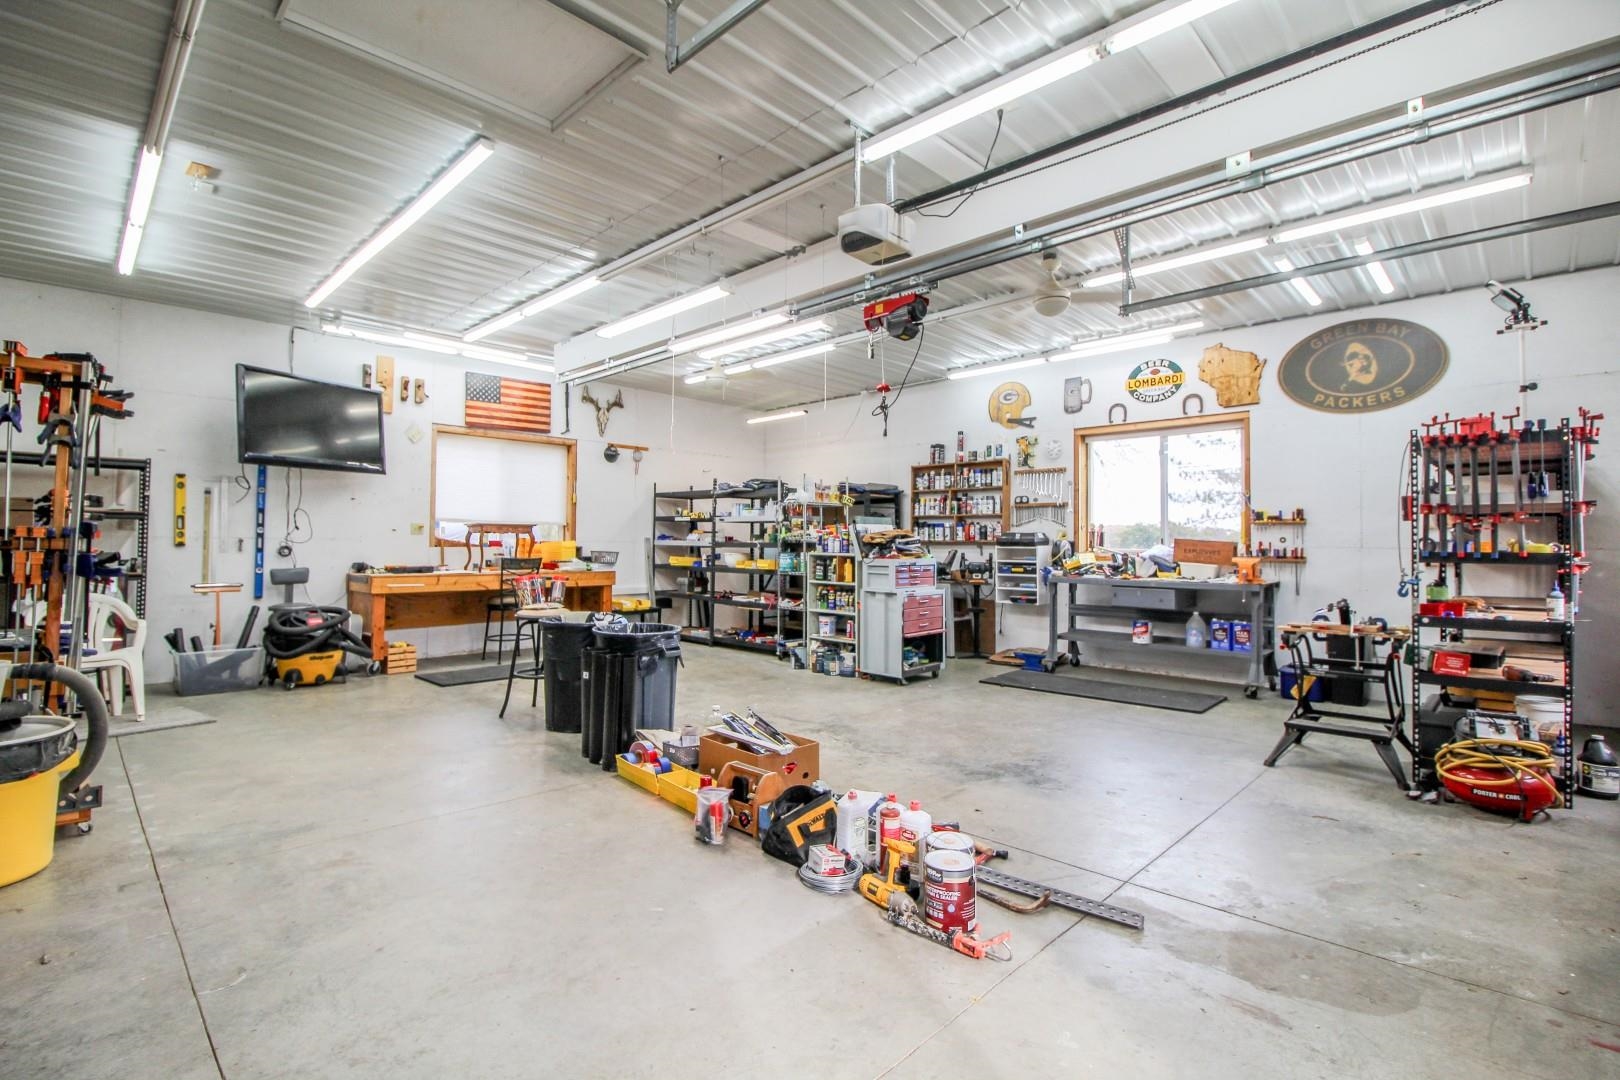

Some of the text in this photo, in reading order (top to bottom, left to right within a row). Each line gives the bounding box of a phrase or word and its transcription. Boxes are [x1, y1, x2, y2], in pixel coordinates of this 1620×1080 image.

[1310, 322, 1411, 349] GREEN BAY
[1140, 360, 1169, 370] BEER
[1128, 374, 1182, 389] LOMBARDI
[1133, 386, 1177, 402] COMPANY
[1312, 386, 1406, 408] PACKERS
[1473, 789, 1497, 798] PORTER
